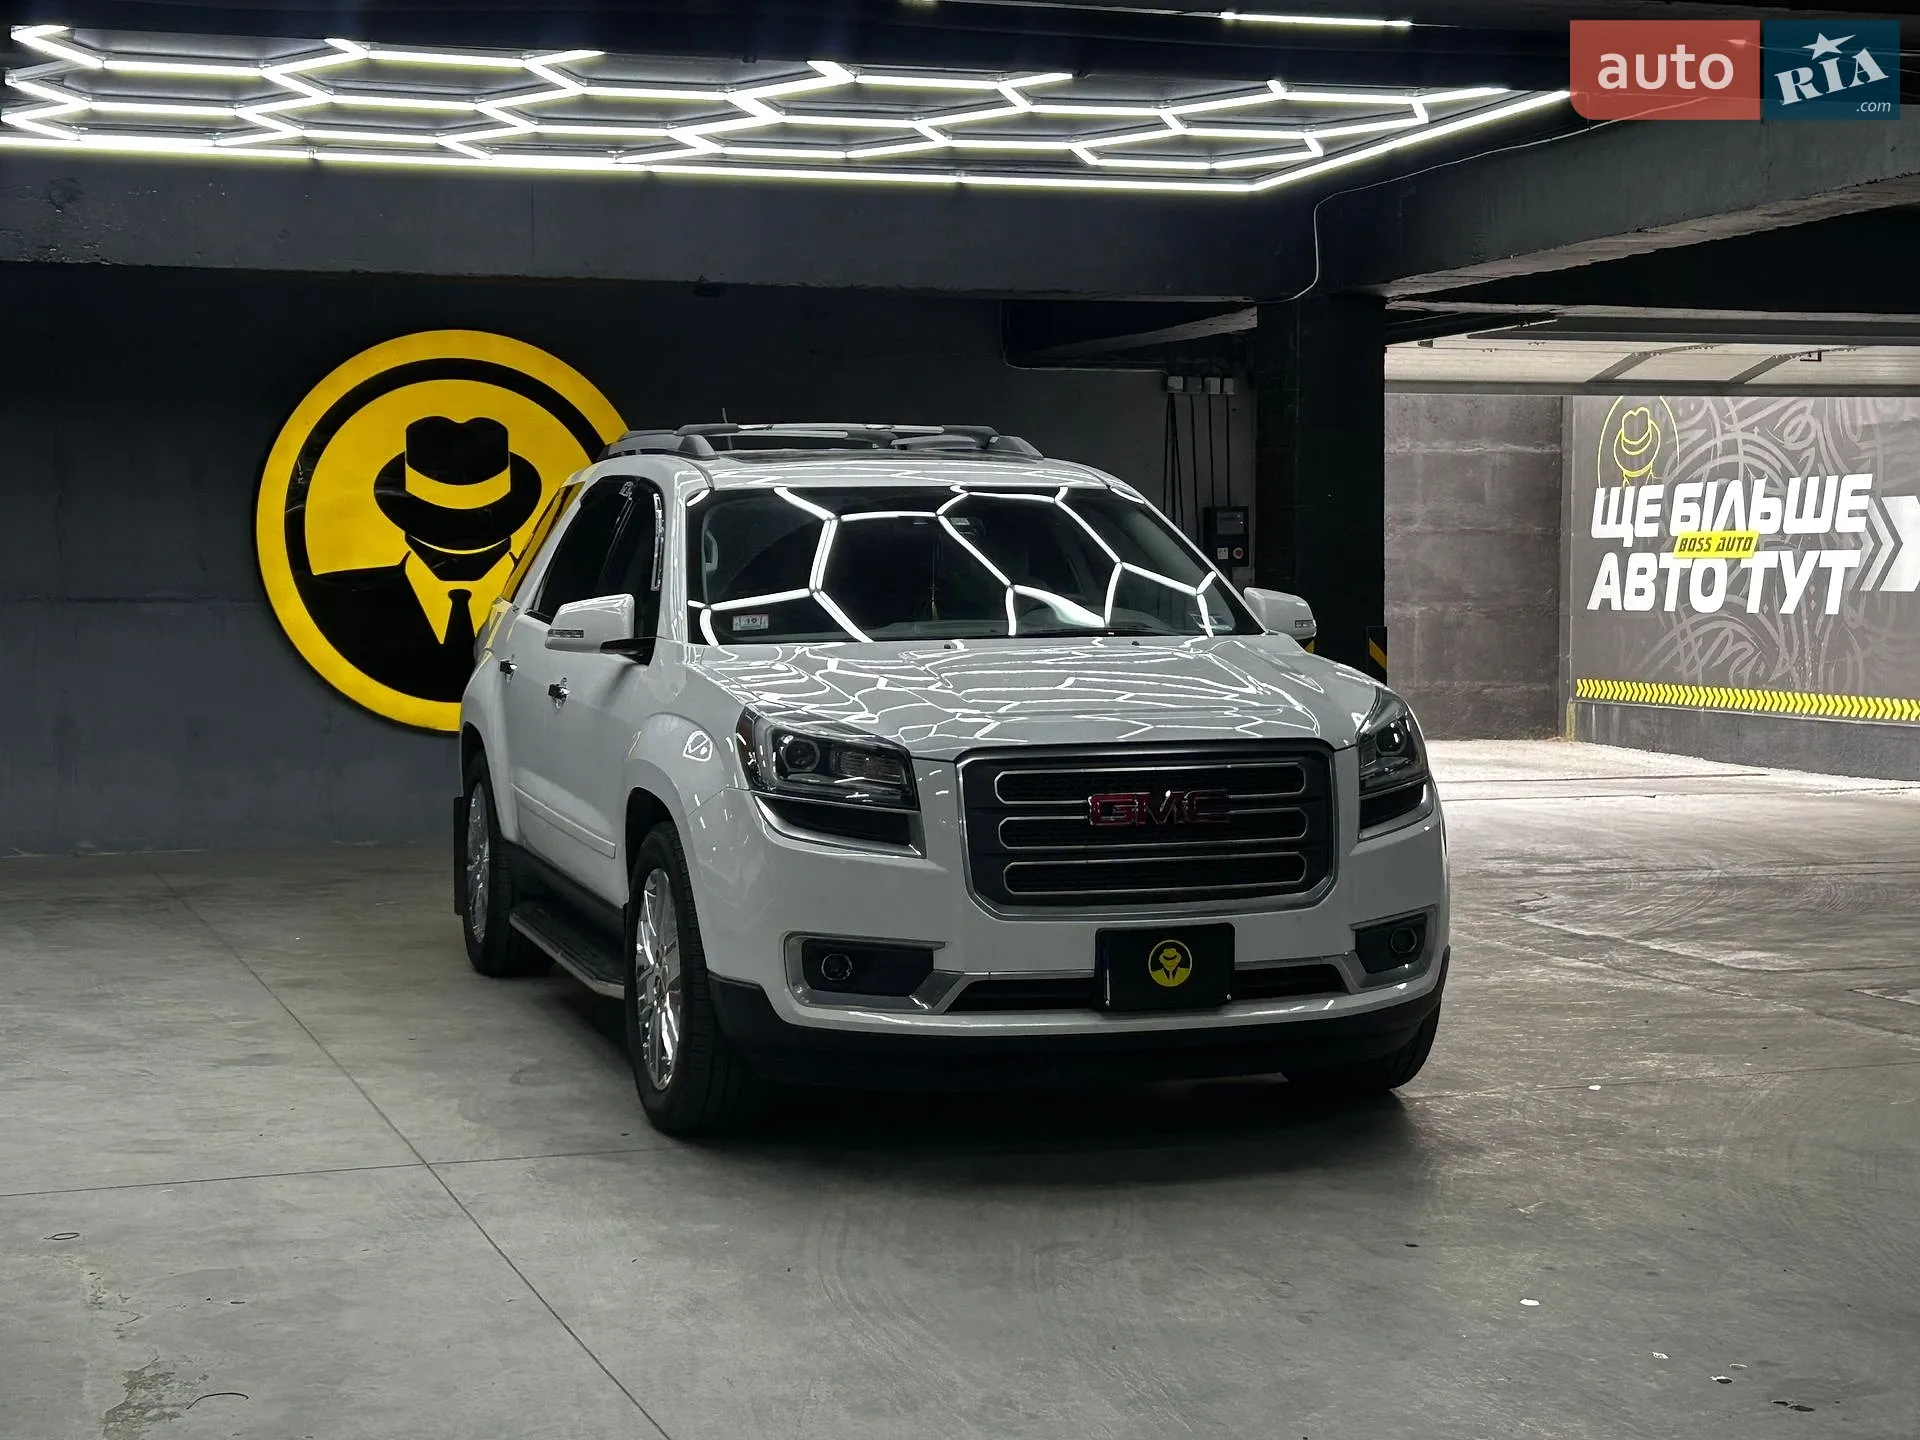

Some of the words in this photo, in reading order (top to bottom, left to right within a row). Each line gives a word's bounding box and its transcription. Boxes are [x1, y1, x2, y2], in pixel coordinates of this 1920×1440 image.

[1591, 484, 1665, 548] ЩЕ
[1669, 473, 1873, 538] БІЛЬШЕ
[1678, 536, 1712, 553] BOSS
[1715, 535, 1754, 552] AUTO
[1586, 551, 1728, 614] АВТО
[1740, 550, 1862, 615] ТУТ
[1088, 789, 1231, 826] GMC
